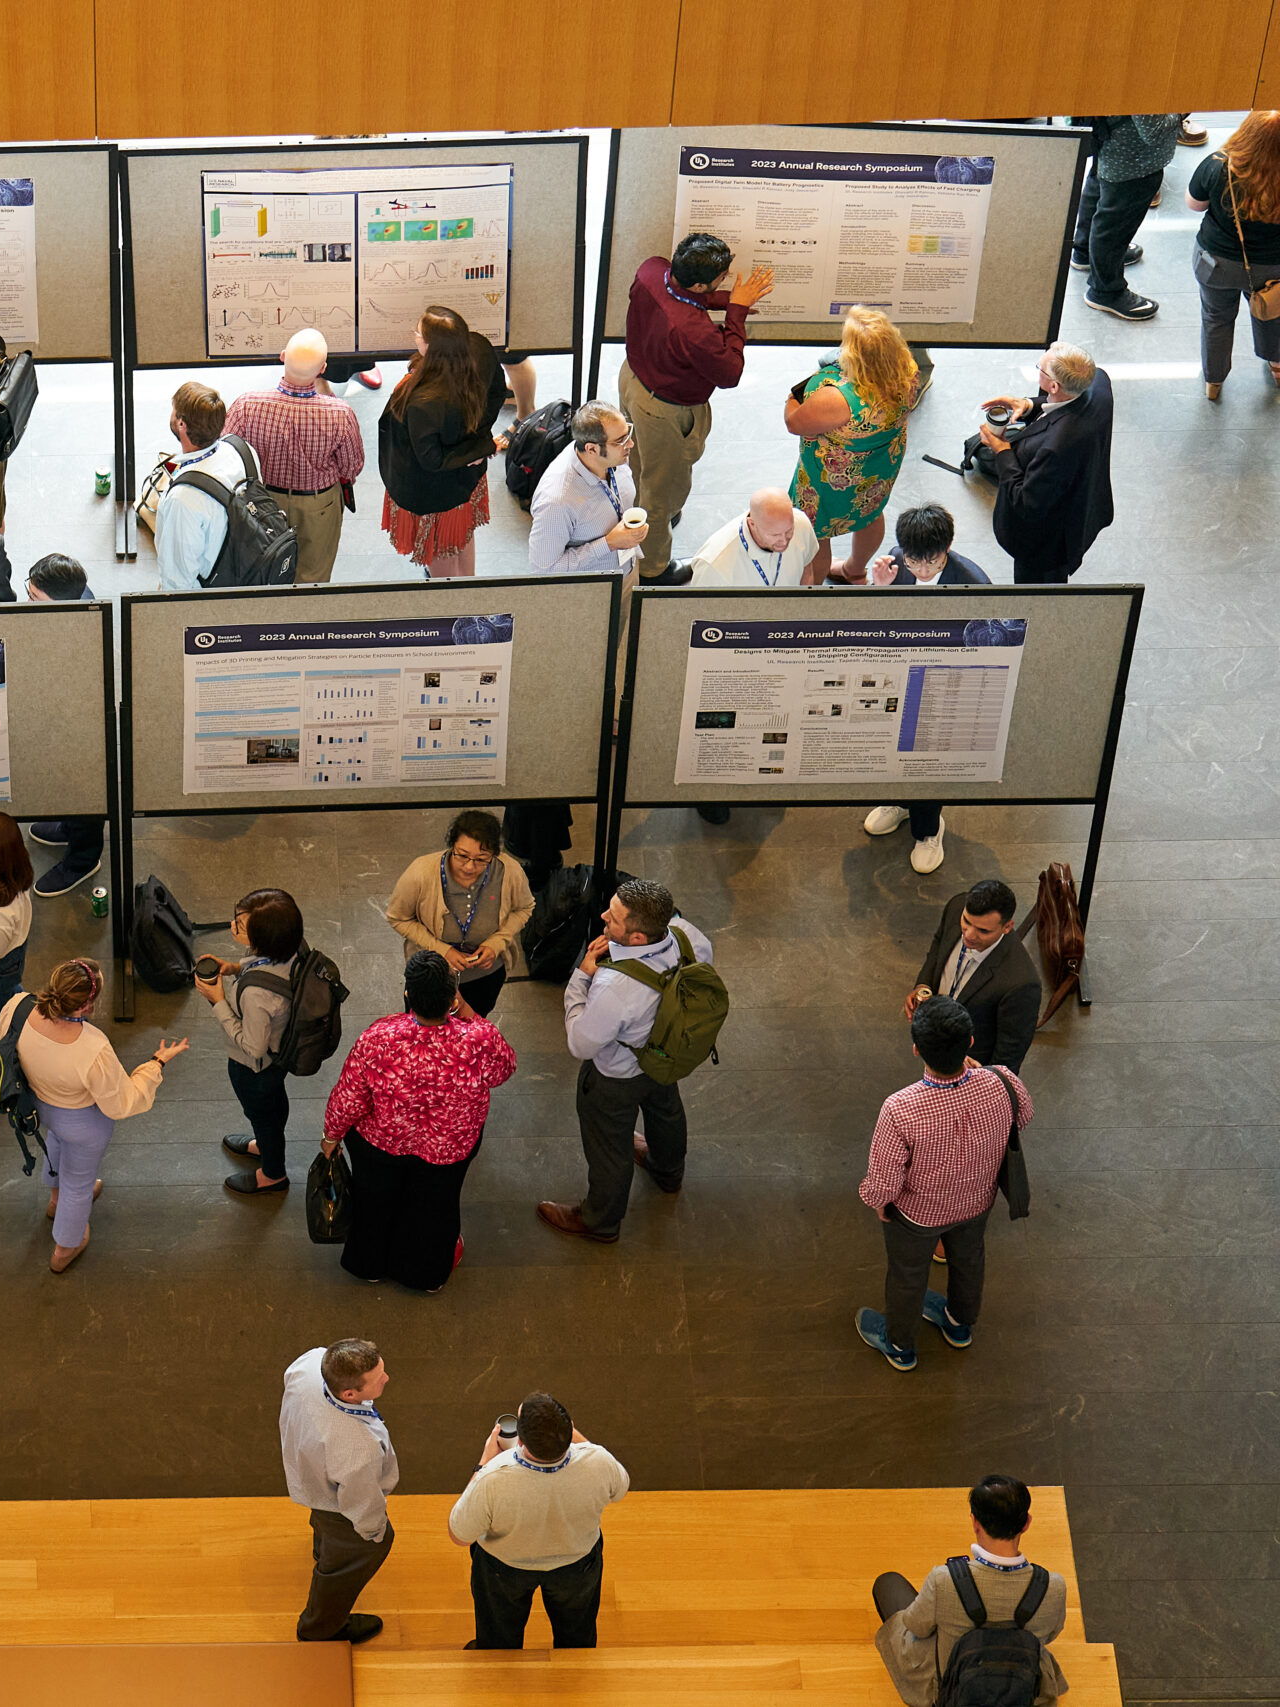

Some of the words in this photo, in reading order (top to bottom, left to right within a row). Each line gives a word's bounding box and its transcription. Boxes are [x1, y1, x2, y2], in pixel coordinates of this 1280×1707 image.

[751, 160, 776, 168] 2023
[779, 161, 813, 170] Annual
[816, 162, 862, 171] Research
[865, 164, 923, 173] Symposium
[328, 631, 376, 640] Research
[379, 630, 439, 639] Symposium
[889, 631, 951, 639] Symposium
